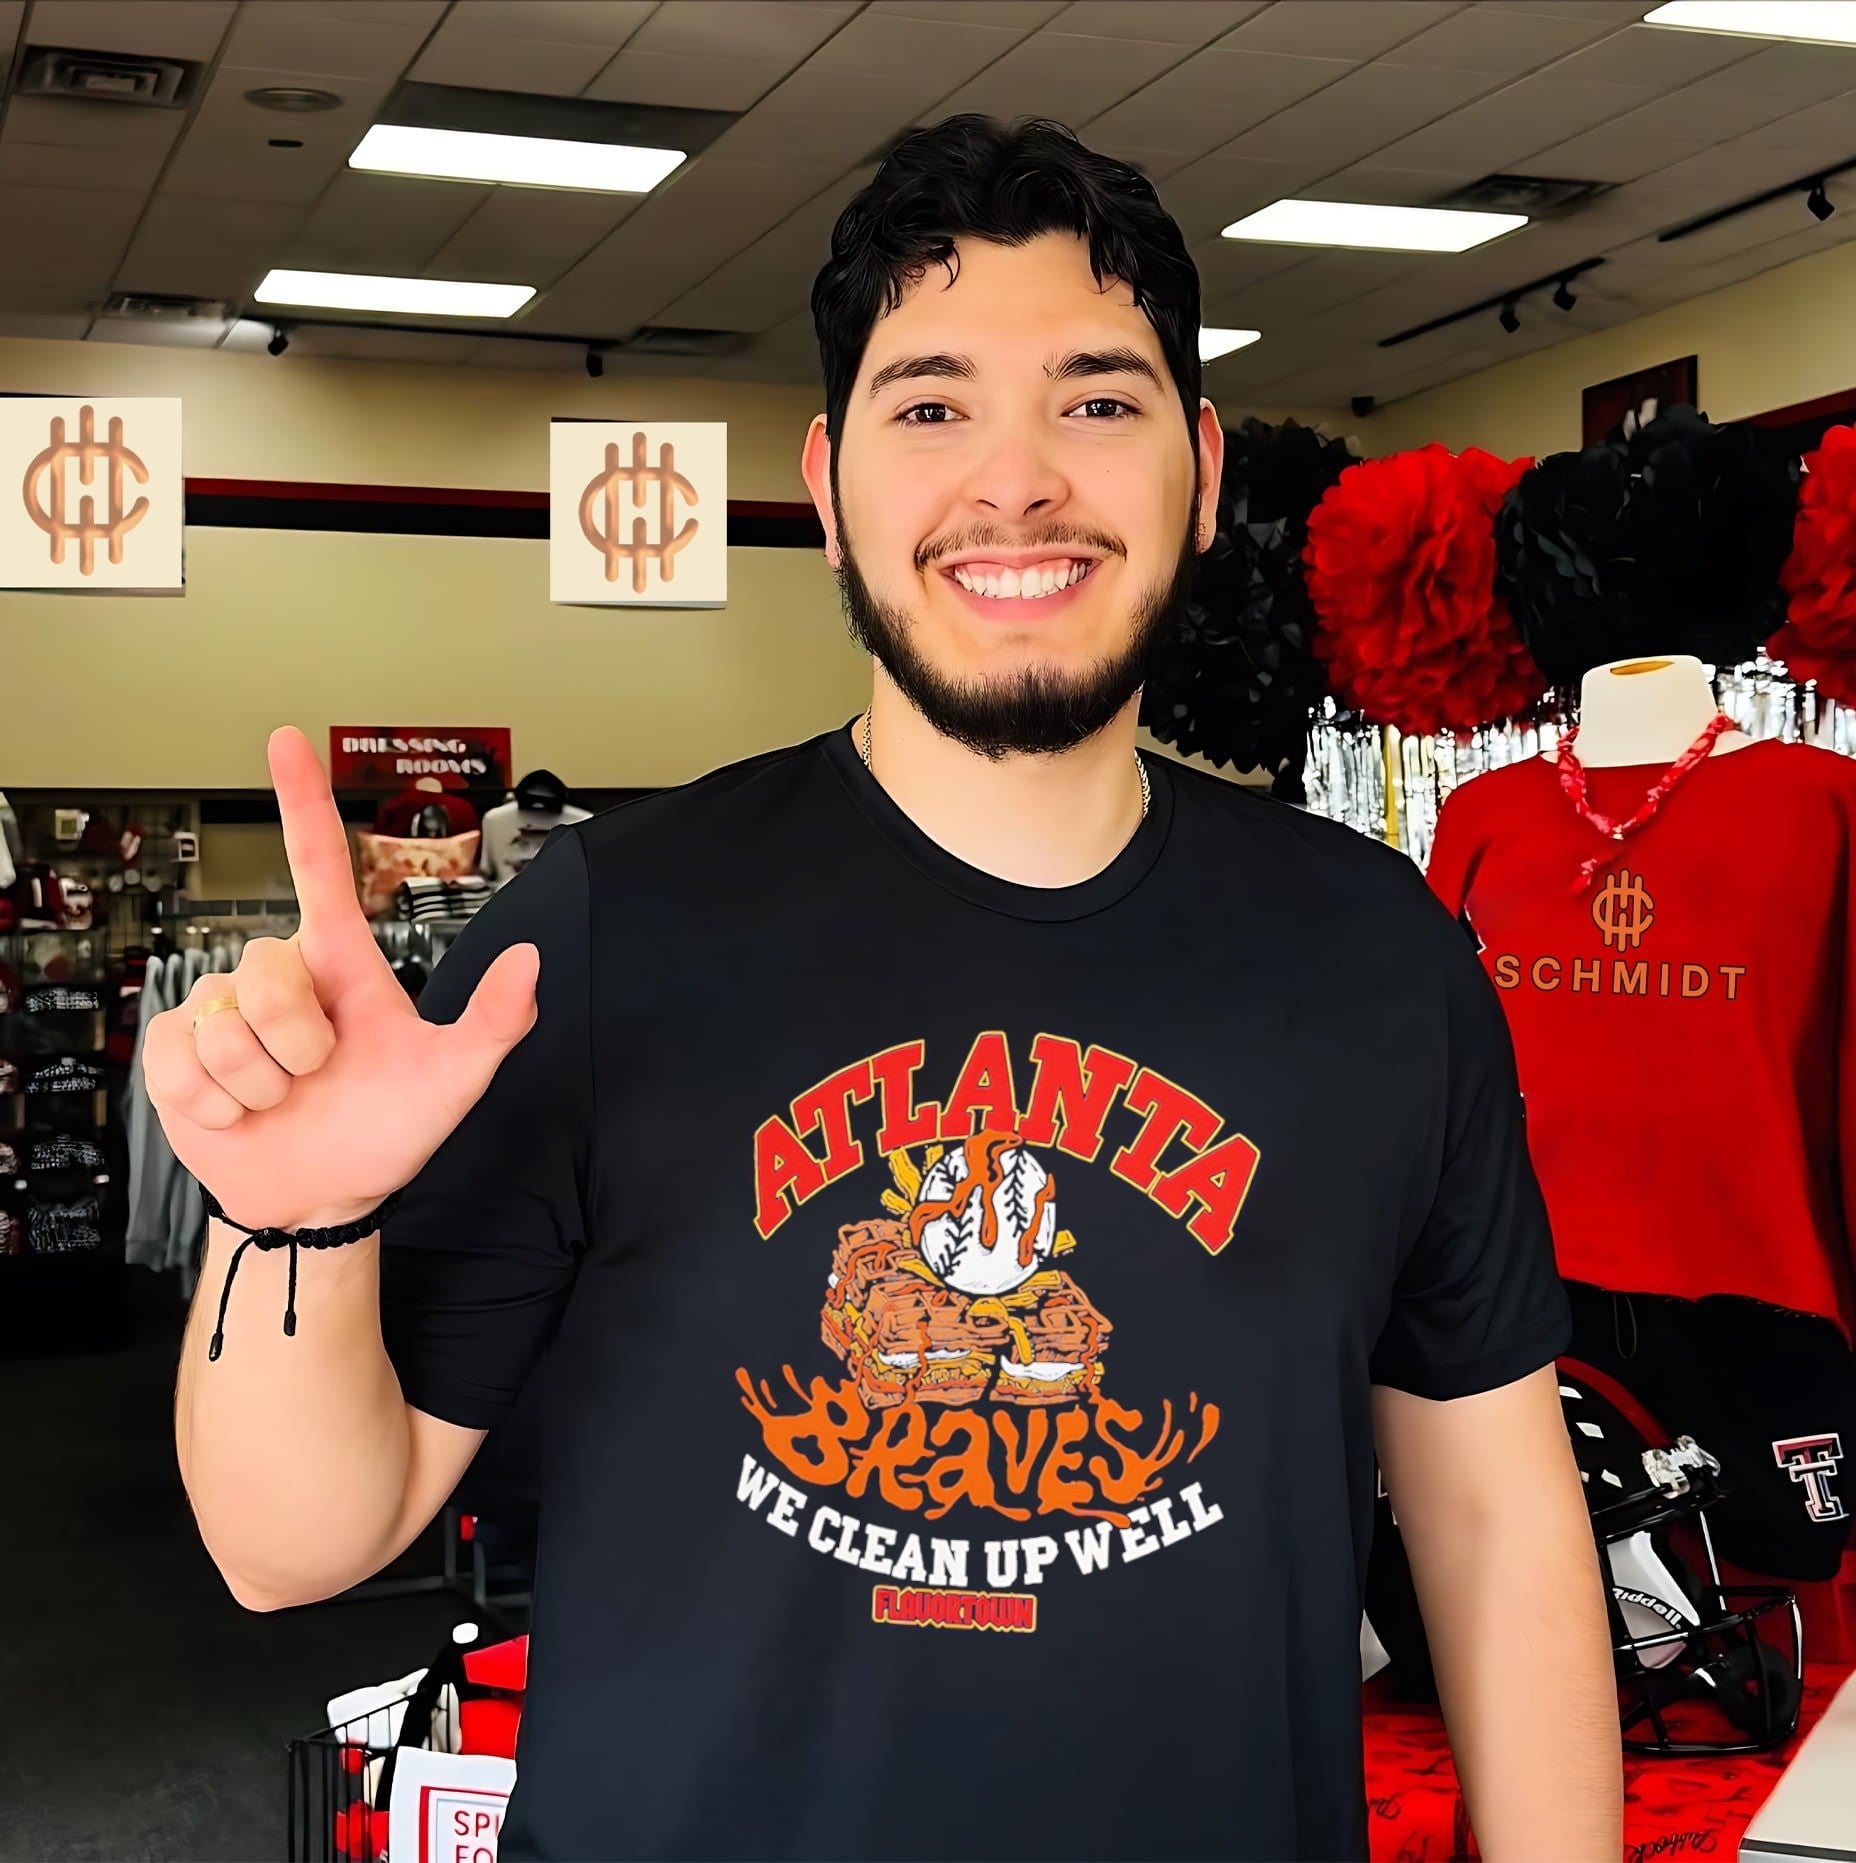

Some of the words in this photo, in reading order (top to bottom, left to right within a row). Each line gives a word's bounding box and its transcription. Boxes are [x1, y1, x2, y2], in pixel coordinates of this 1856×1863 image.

[395, 758, 487, 776] ROOMS
[1494, 954, 1746, 1000] SCHMIDT
[754, 1031, 1260, 1255] ATLANTA
[736, 1454, 807, 1537] WE
[807, 1505, 969, 1587] CLEAN
[984, 1536, 1059, 1588] UP
[1064, 1481, 1224, 1575] WELL
[873, 1586, 1036, 1631] FLAVORTOWN
